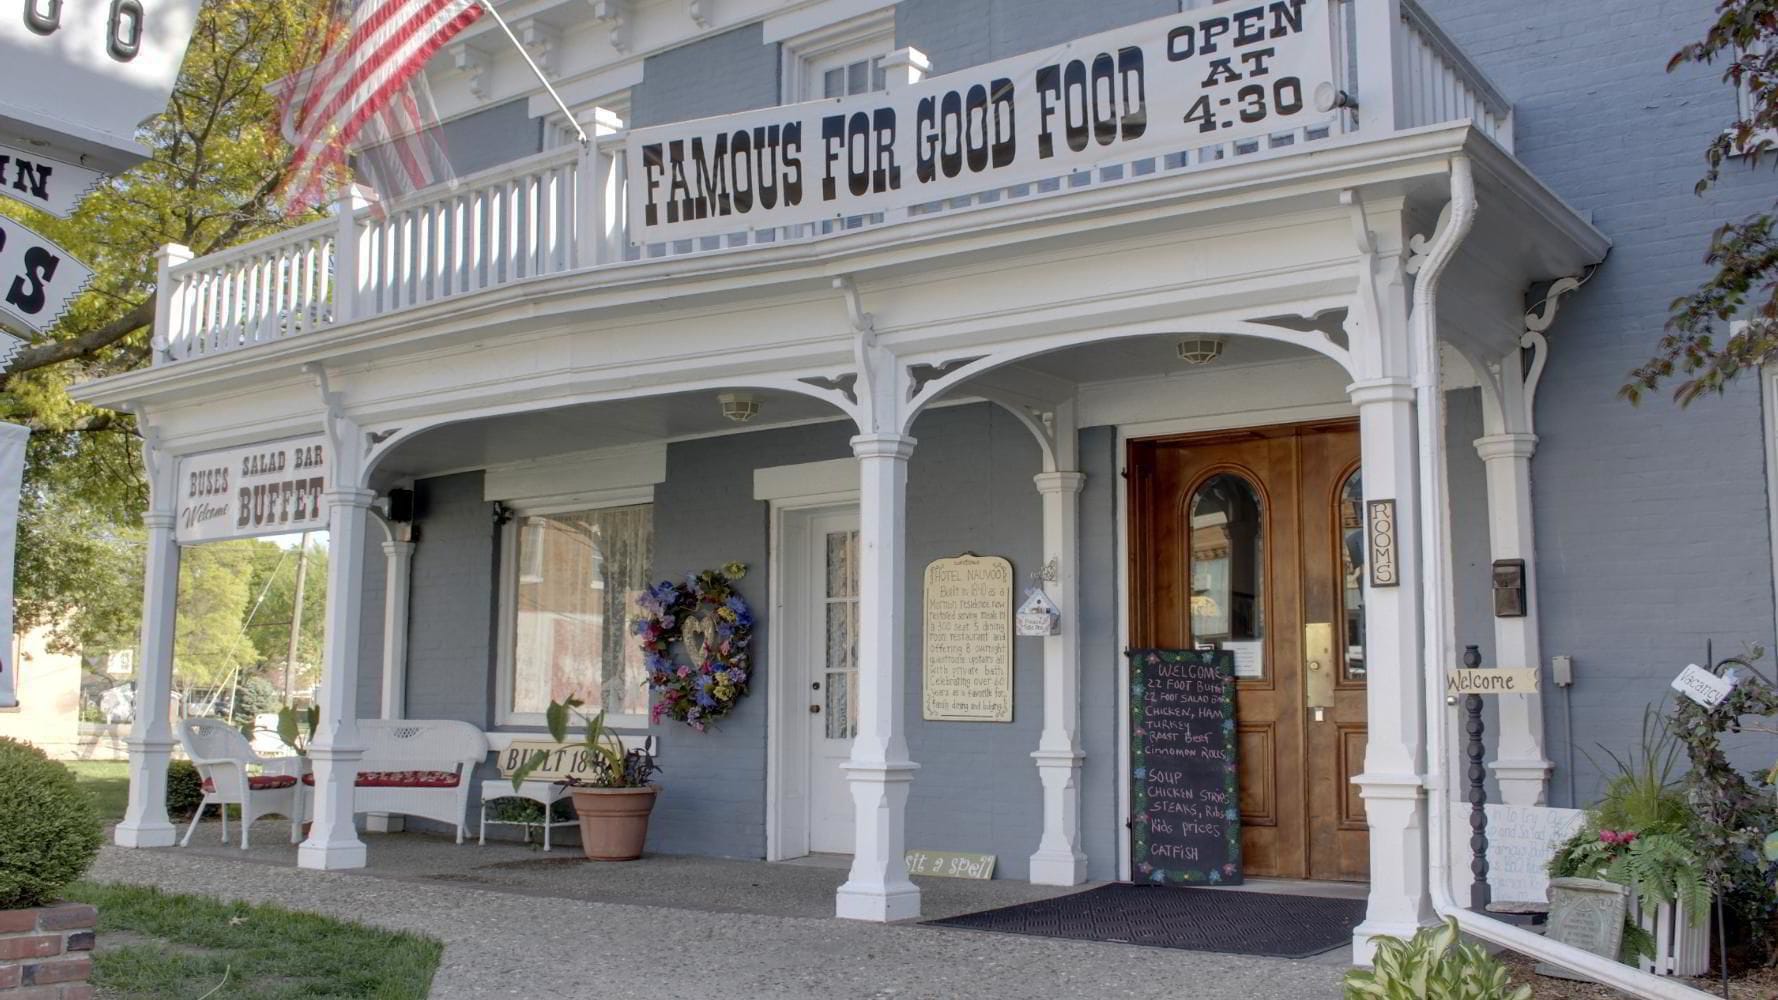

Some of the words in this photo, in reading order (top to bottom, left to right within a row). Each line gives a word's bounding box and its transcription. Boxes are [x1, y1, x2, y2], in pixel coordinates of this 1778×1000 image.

[1167, 0, 1306, 62] OPEN
[1201, 47, 1275, 88] AT
[1184, 76, 1303, 133] 4:30
[642, 120, 803, 226] FAMOUS
[822, 107, 901, 201] FOR
[917, 77, 1016, 183] GOOD
[1036, 45, 1147, 159] FOOD
[0, 227, 60, 315] S
[242, 451, 286, 476] SALAD
[294, 445, 324, 468] BAR
[190, 467, 229, 497] BUSES
[238, 476, 324, 528] BUFFET
[182, 502, 229, 528] Welcome
[1373, 503, 1392, 582] ROOMS
[935, 570, 961, 581] HOTEL
[967, 569, 1001, 581] NAUVOO
[1158, 664, 1223, 679] WELCOME
[1446, 669, 1516, 692] Welcome
[1144, 692, 1157, 702] 22
[1160, 692, 1179, 701] FOOT
[1180, 695, 1209, 703] SALAD
[1147, 679, 1162, 688] 22
[1166, 679, 1192, 691] FOOT
[1680, 668, 1723, 705] Vacancy
[1198, 707, 1223, 719] HAM
[1150, 731, 1179, 743] ROAST
[506, 748, 566, 772] BULT
[1148, 768, 1182, 784] SOUP
[1147, 786, 1193, 799] CHICKEN
[1151, 818, 1173, 834] Kids
[1182, 819, 1221, 838] prices
